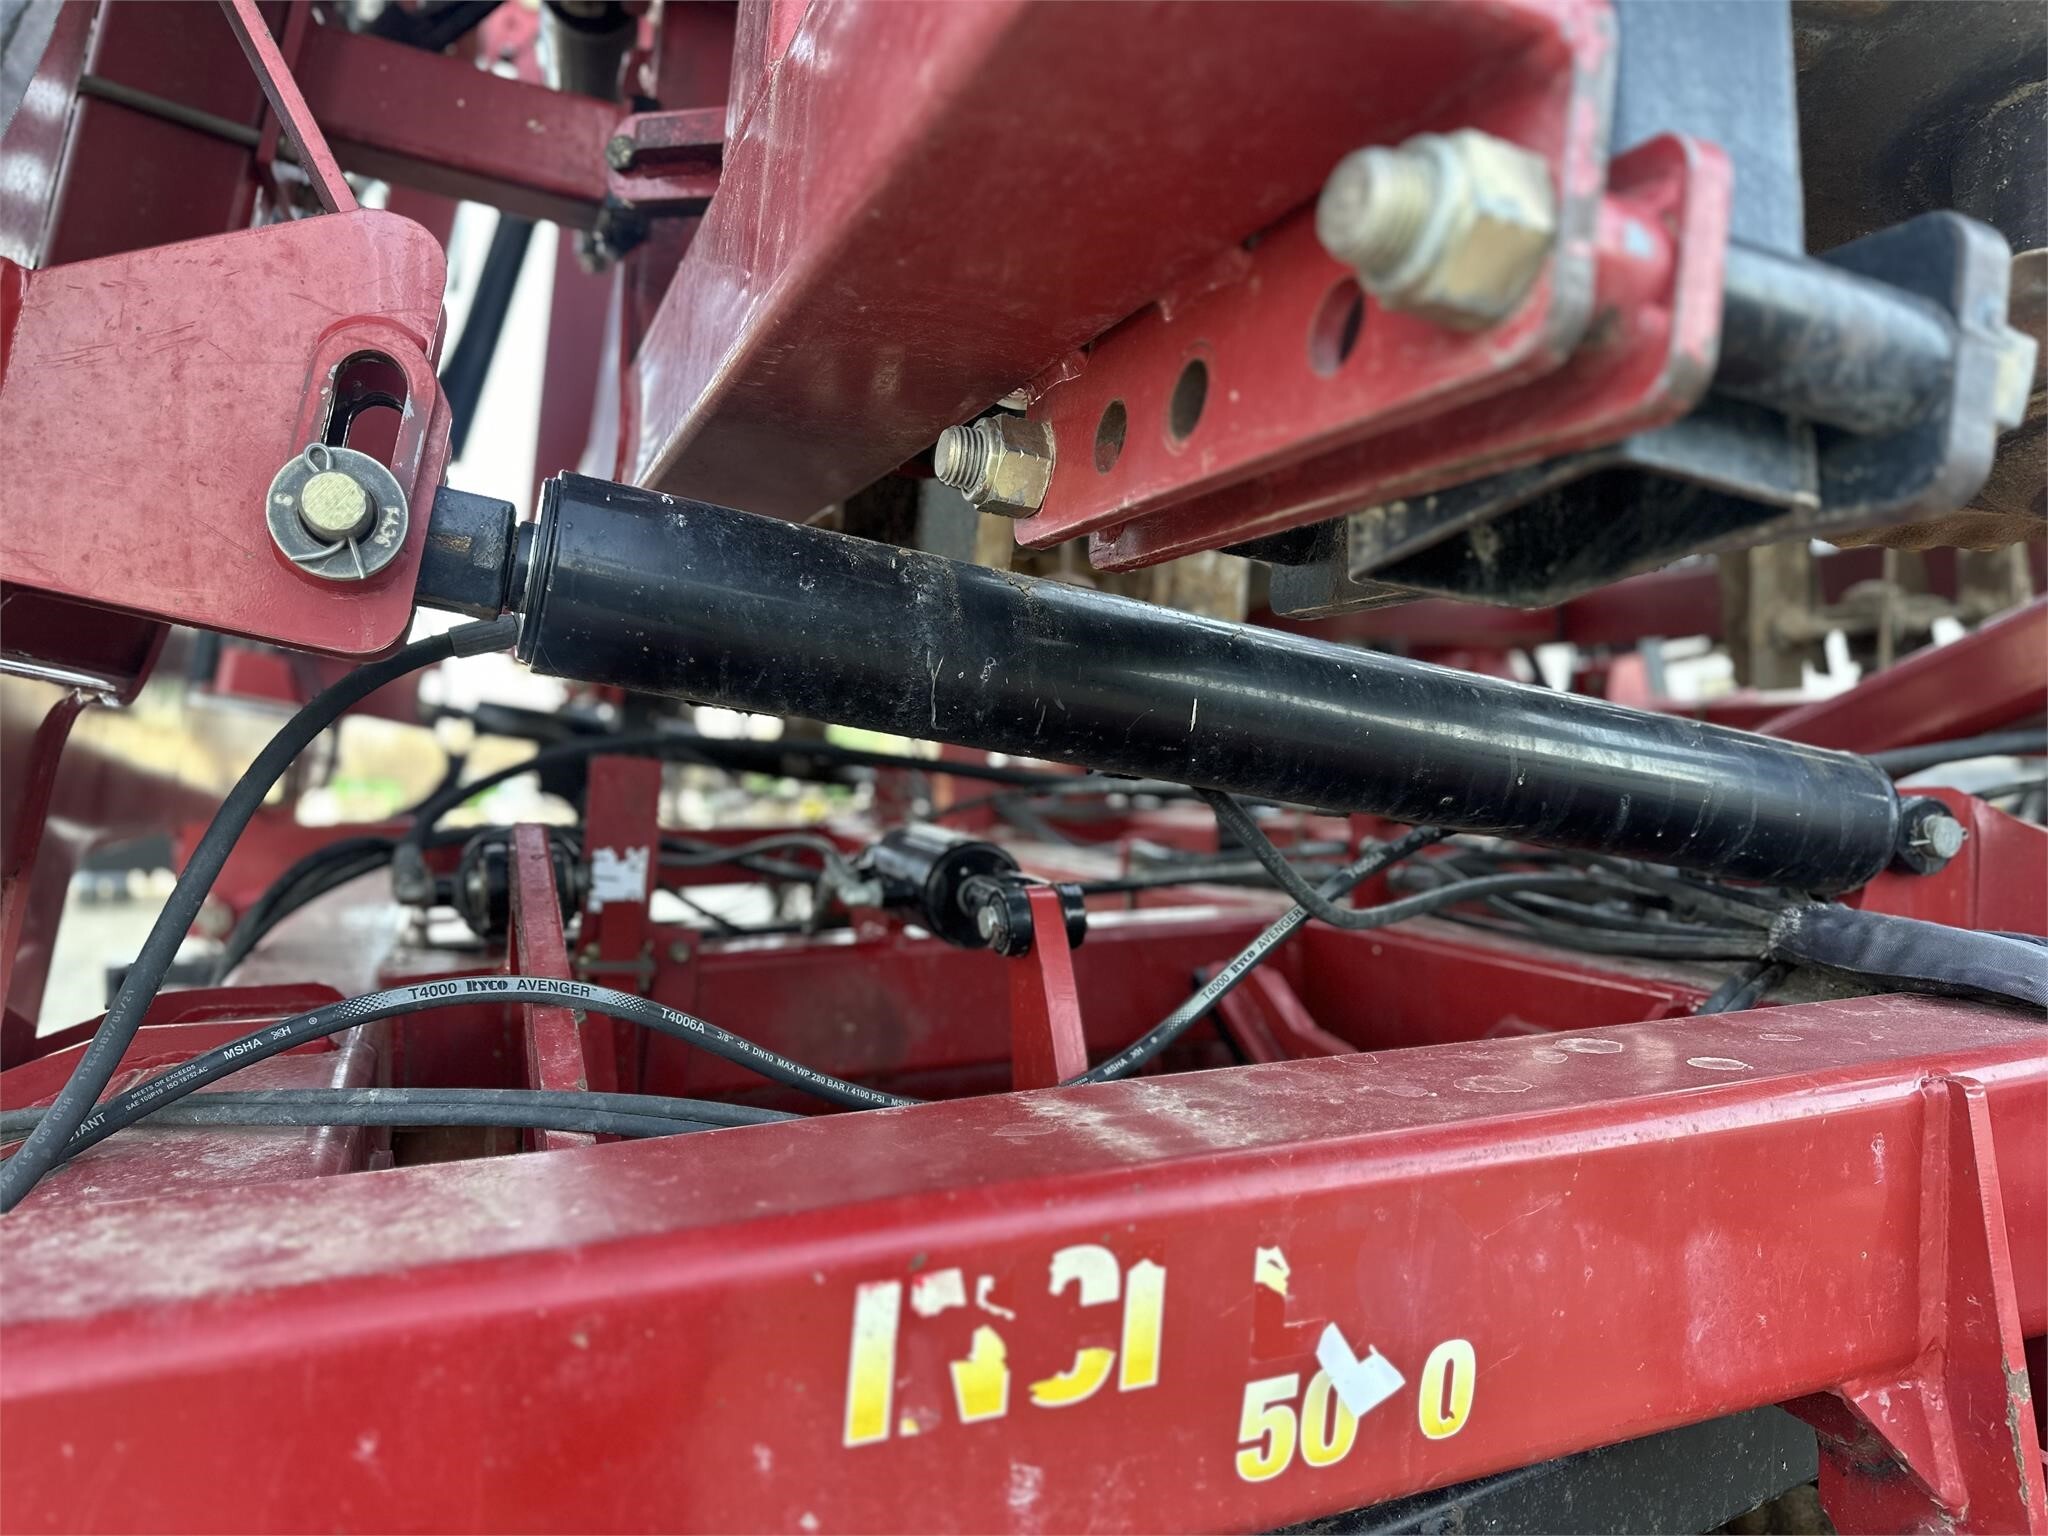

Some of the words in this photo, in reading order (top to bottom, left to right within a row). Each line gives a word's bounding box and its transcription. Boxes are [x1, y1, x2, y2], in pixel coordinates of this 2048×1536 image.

[1202, 973, 1230, 1001] T4000
[1230, 950, 1256, 975] RYCO
[1257, 908, 1303, 950] AVENGER
[408, 982, 458, 1000] T4000
[466, 980, 509, 992] RYCO
[223, 1038, 263, 1060] MSHA
[661, 1007, 705, 1034] T4006A
[752, 1047, 774, 1062] DN10
[777, 1058, 796, 1073] MAX
[797, 1067, 811, 1077] WP
[827, 1078, 846, 1092] BAR
[851, 1087, 870, 1099] 4100
[871, 1093, 885, 1104] PSI
[131, 1085, 153, 1100] MEETS
[154, 1079, 165, 1088] OR
[165, 1064, 196, 1084] EXCEEDS
[1103, 1058, 1129, 1076] MSHA
[125, 1101, 139, 1111] SAE
[167, 1080, 179, 1090] ISO
